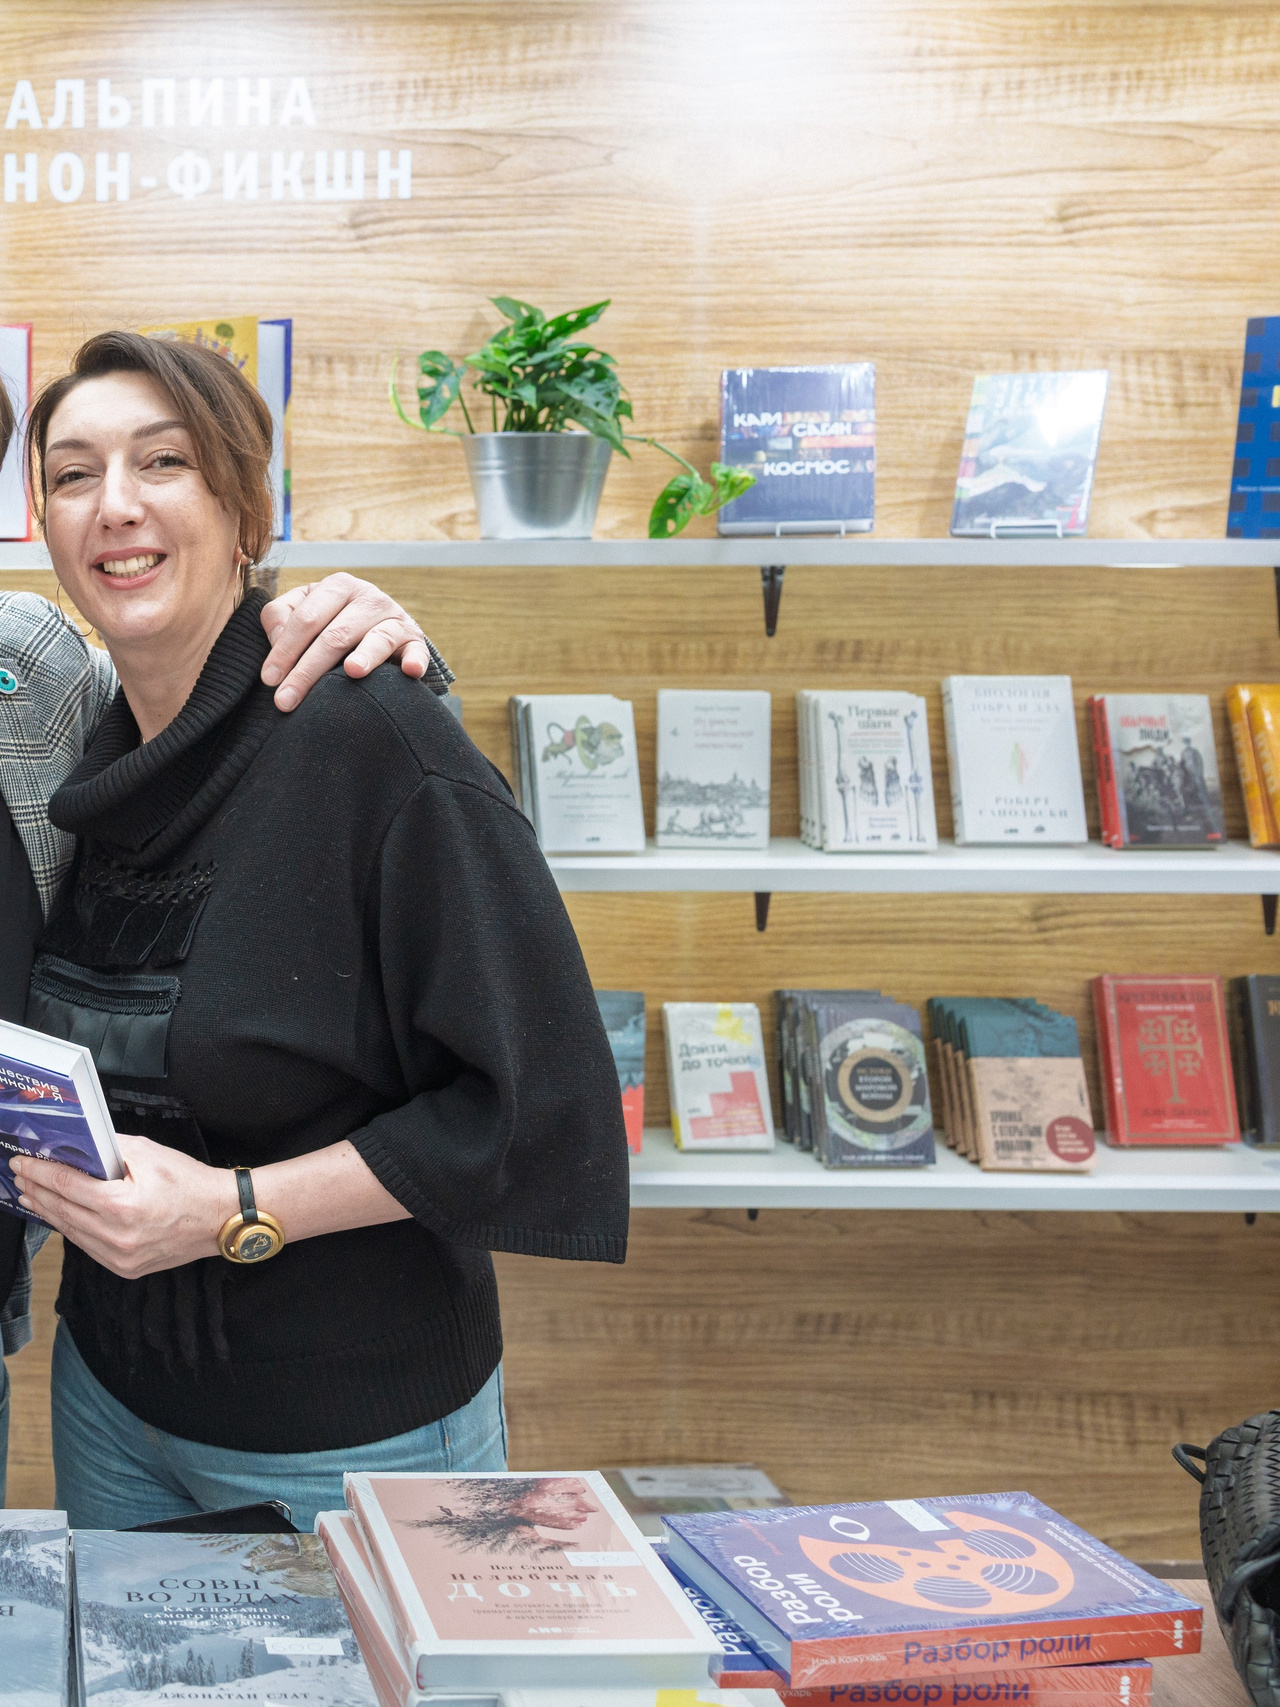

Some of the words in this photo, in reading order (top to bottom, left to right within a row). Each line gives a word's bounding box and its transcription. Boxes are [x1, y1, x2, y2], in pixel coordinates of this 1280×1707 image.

[5, 77, 318, 130] АЛЬПИНА
[4, 148, 413, 203] НОН-ФИКШН
[763, 459, 851, 477] КОСМОС
[52, 1092, 64, 1103] Я
[450, 1573, 615, 1581] Нелюбимая
[520, 1564, 564, 1572] Стрип
[158, 1578, 262, 1590] СОВЫ
[733, 1555, 823, 1625] Разбор
[126, 1591, 172, 1603] ВО
[186, 1592, 303, 1605] ЛЬДАХ
[786, 1572, 864, 1623] роли
[904, 1636, 1010, 1666] Разбор
[1020, 1633, 1092, 1657] роли
[157, 1692, 258, 1700] ДЖОНАТАН
[266, 1692, 312, 1700] СЛАТ
[830, 1681, 943, 1707] Разбор
[952, 1682, 1030, 1707] роли
